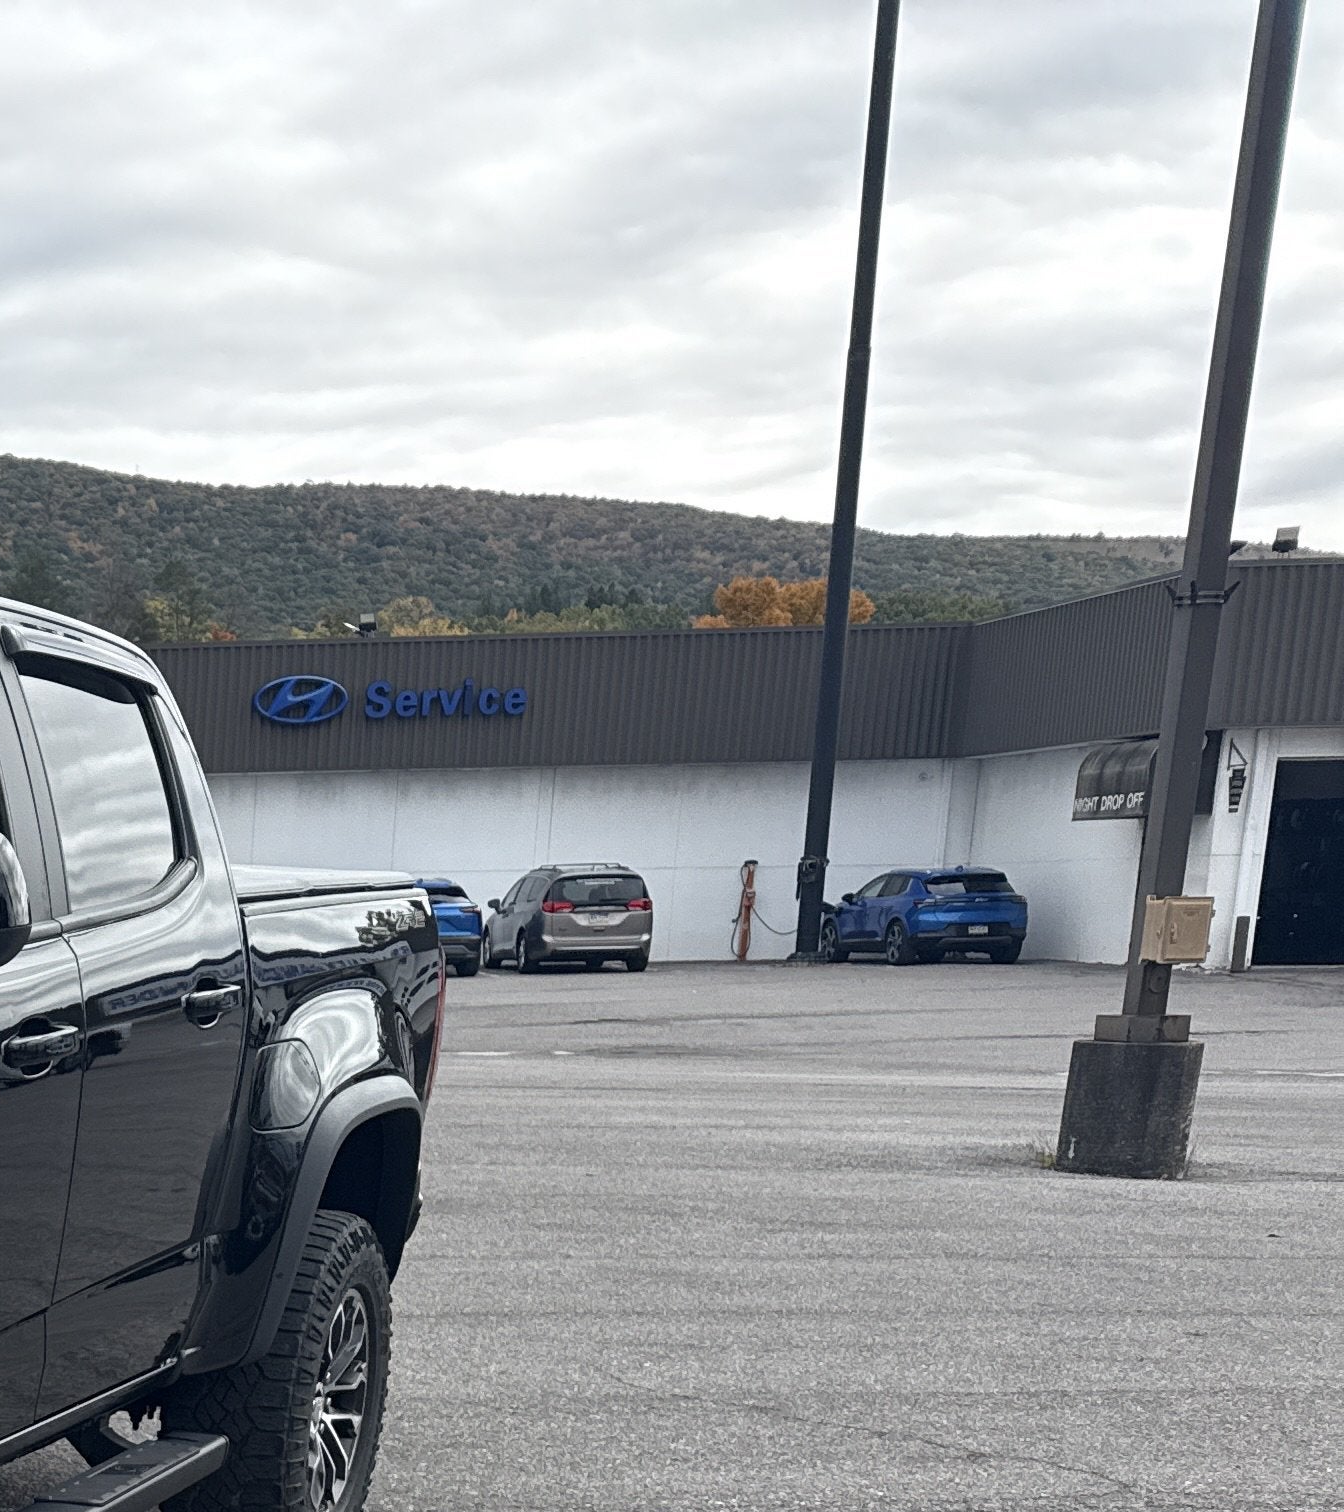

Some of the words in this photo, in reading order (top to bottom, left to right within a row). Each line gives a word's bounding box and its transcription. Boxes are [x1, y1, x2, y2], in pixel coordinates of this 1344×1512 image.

[365, 678, 527, 719] Service
[1100, 794, 1125, 811] DROP
[1126, 791, 1145, 808] OFF
